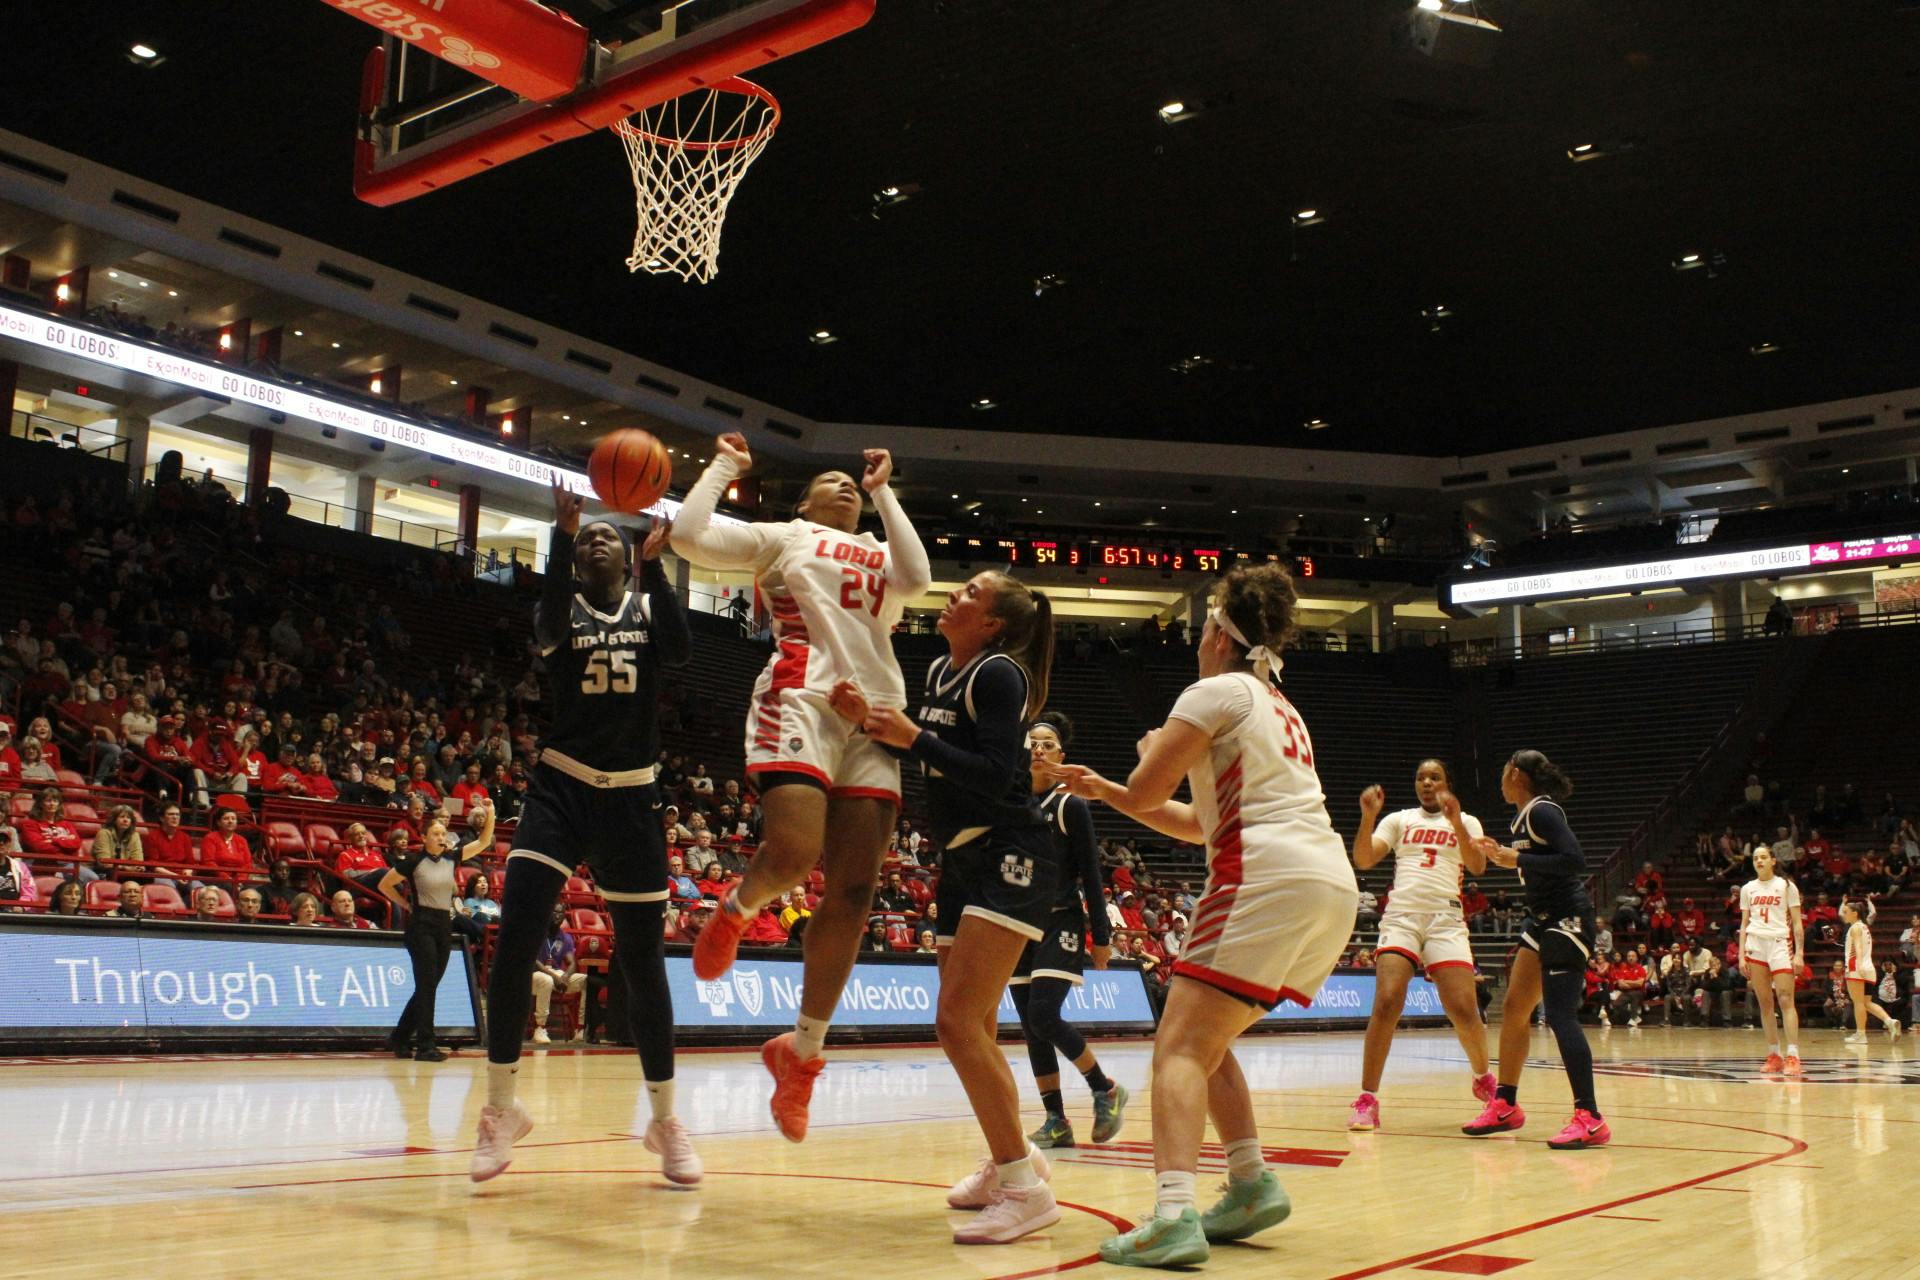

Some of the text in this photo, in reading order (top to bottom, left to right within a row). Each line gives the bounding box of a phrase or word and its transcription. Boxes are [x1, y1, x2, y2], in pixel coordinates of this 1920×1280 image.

[46, 326, 65, 344] GO
[222, 376, 238, 392] GO
[373, 420, 388, 435] GO
[508, 458, 521, 472] GO
[815, 540, 884, 570] LOBO
[1036, 548, 1056, 562] 54
[1070, 551, 1079, 563] 3
[1104, 547, 1182, 569] 6:57 4 2
[1199, 556, 1218, 570] 57
[1751, 555, 1765, 566] GO
[1304, 562, 1313, 576] 3
[1625, 568, 1638, 580] GO
[840, 567, 887, 618] 24
[1507, 582, 1519, 593] GO
[608, 630, 649, 645] STATE
[581, 649, 638, 694] 55
[1403, 829, 1457, 848] LOBOS
[1420, 848, 1438, 868] 3
[1001, 863, 1033, 880] STATE
[1750, 896, 1782, 906] LOBOS
[1760, 908, 1769, 924] 4
[55, 957, 278, 1021] Through
[295, 965, 326, 1007] It
[841, 978, 929, 1010] Mexico
